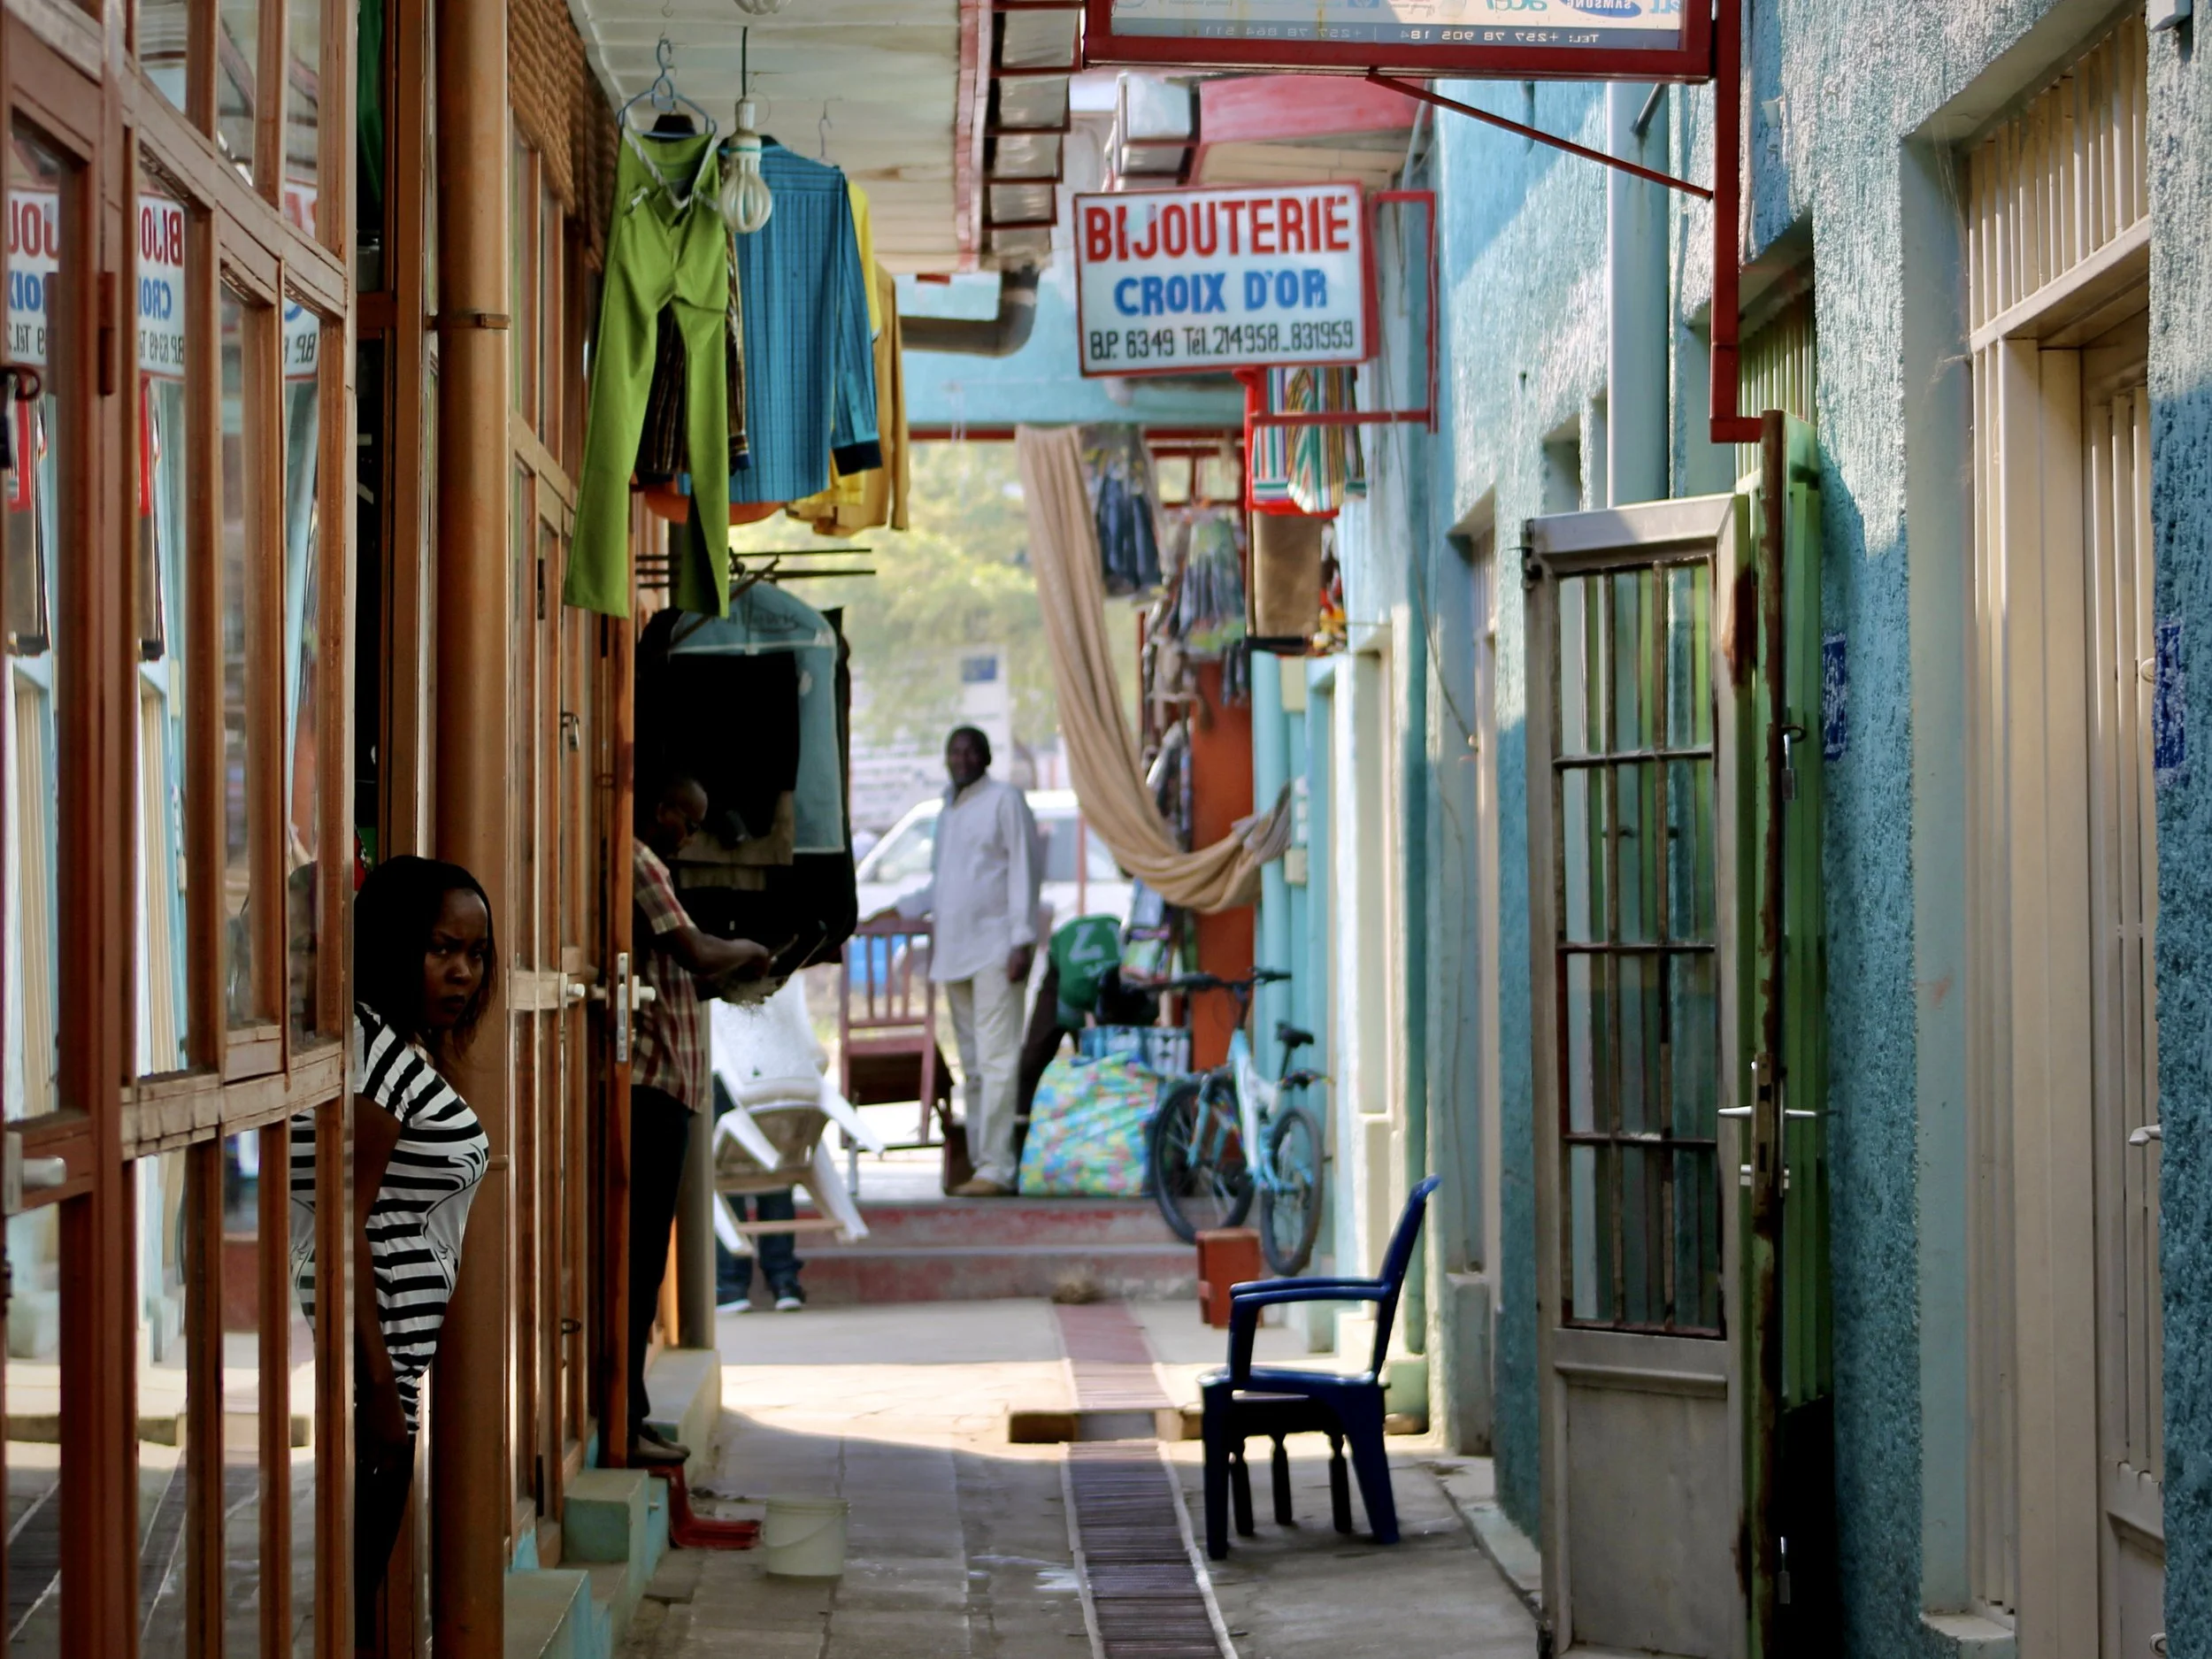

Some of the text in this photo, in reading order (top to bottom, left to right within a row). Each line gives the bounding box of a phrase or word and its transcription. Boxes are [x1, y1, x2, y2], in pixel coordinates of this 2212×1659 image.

[1085, 196, 1349, 262] BIJOUTERIE
[1114, 269, 1326, 317] CROIX D'OR
[1126, 327, 1174, 358] 6349
